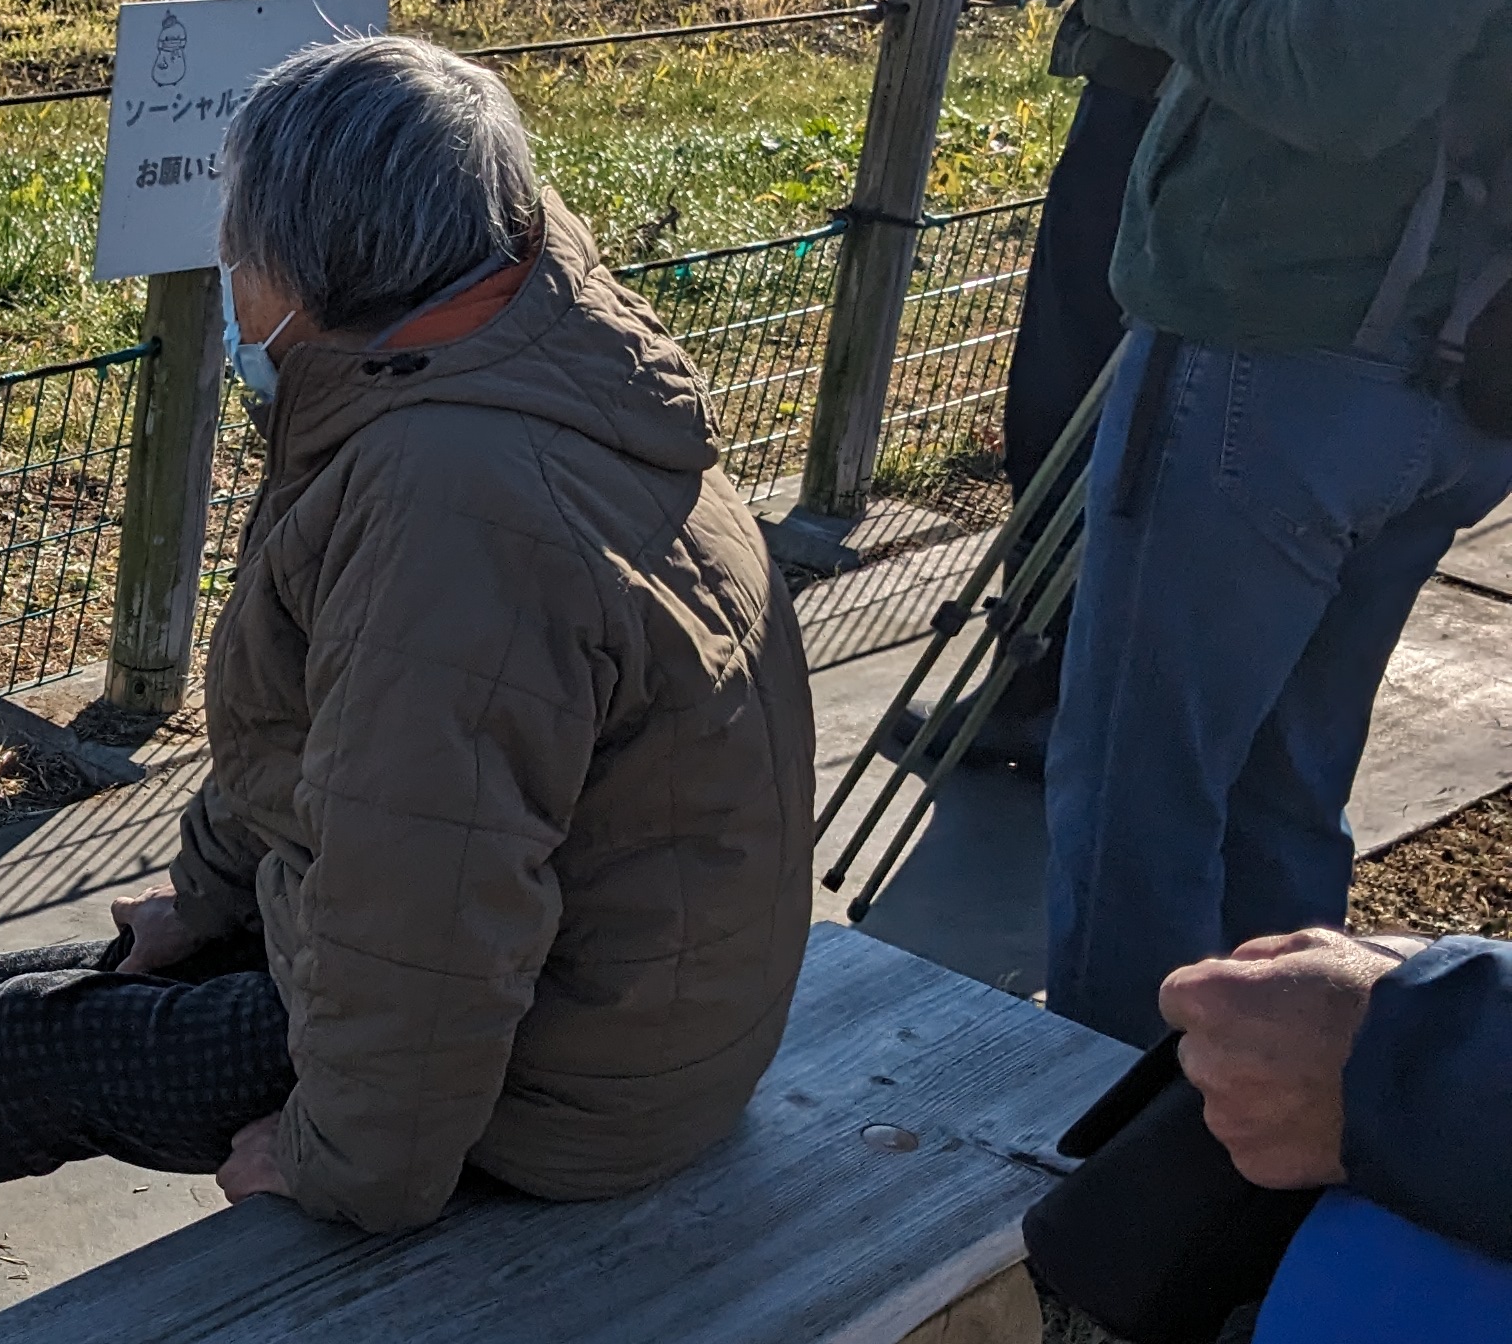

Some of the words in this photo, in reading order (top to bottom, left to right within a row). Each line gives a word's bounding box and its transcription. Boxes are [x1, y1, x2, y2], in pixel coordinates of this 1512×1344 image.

[126, 87, 252, 127] ソーシャル
